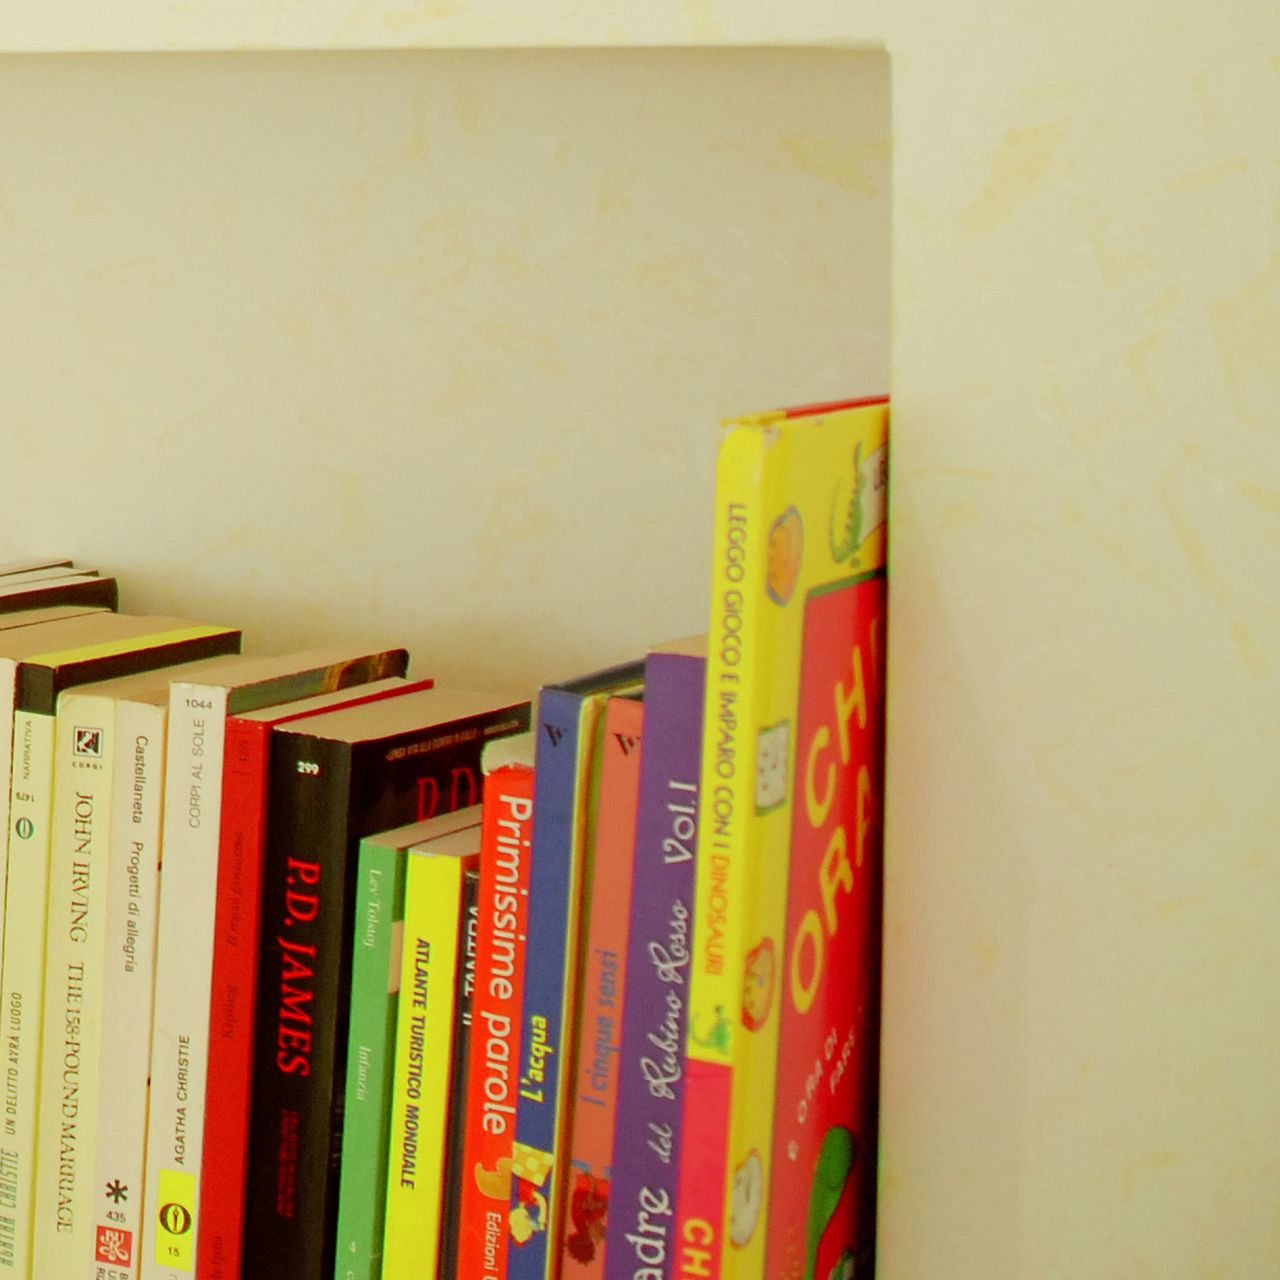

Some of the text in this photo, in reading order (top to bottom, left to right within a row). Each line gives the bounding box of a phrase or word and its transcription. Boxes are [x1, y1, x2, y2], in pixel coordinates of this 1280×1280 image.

[132, 734, 149, 824] Castellaneta
[704, 502, 748, 977] LEGGO GIOCO E IMPARO CON I DINOSAURI
[69, 791, 94, 945] JOHN IRVING
[122, 840, 145, 973] Progetti di allegria
[284, 857, 321, 928] P.D.
[276, 935, 317, 1078] JAMES
[480, 793, 533, 1135] Primissime parole
[56, 961, 85, 1235] THE 158-POUND MARRIAGE
[400, 937, 431, 1191] ATLANTE TURISTICO MONDIALE
[519, 1015, 554, 1104] L'acqua
